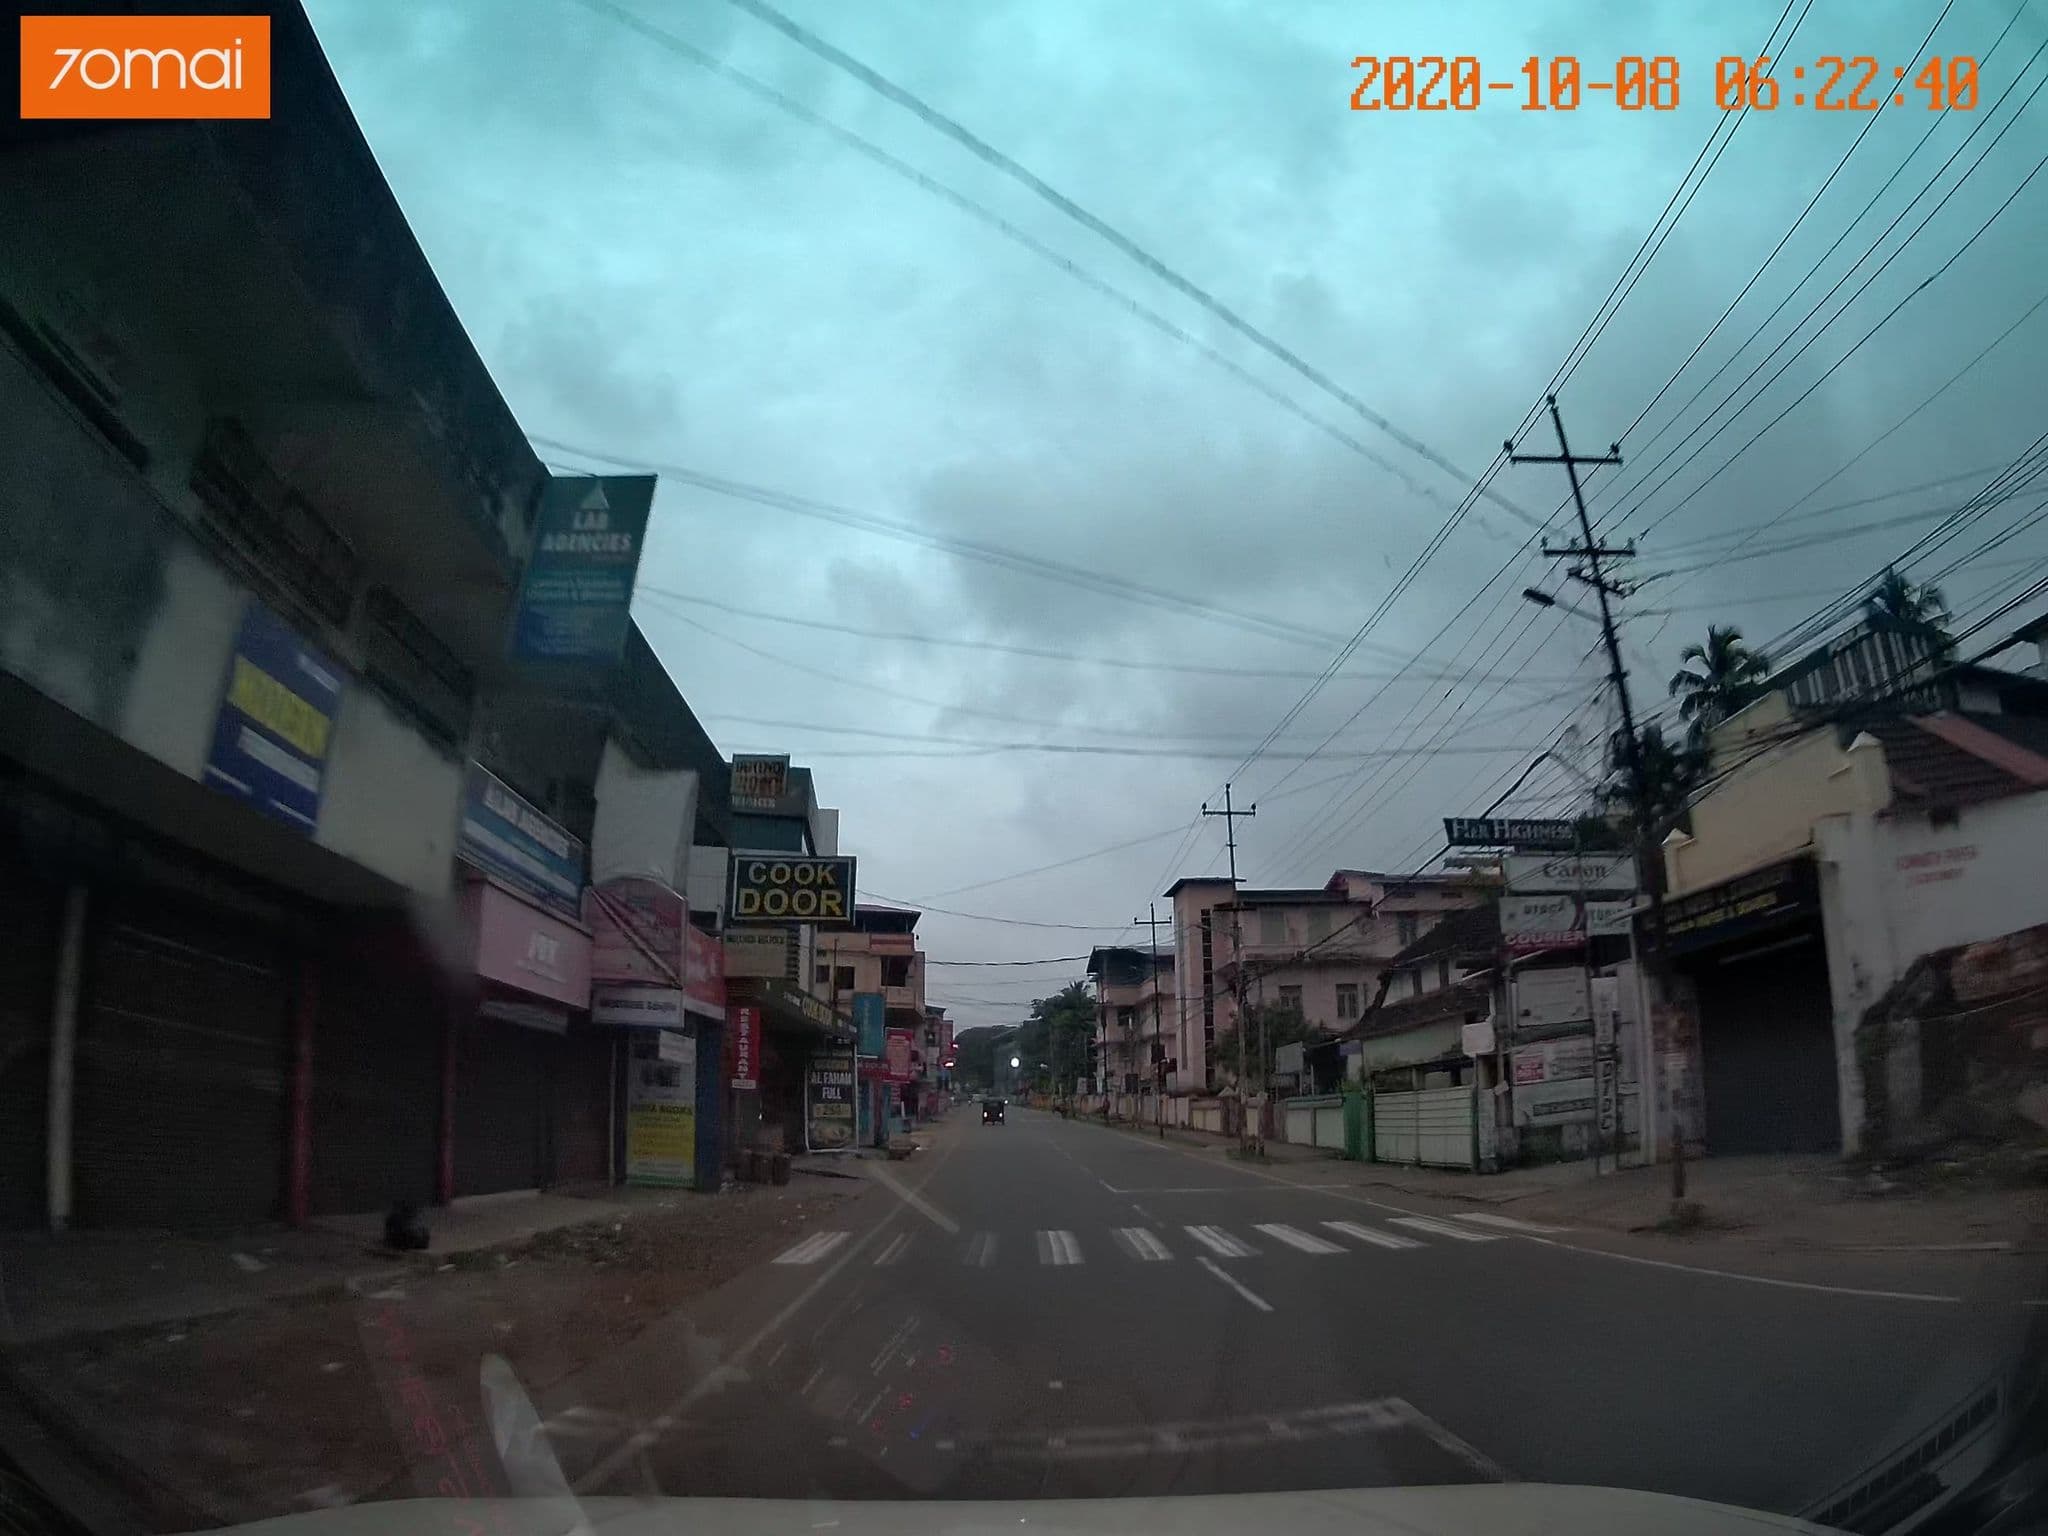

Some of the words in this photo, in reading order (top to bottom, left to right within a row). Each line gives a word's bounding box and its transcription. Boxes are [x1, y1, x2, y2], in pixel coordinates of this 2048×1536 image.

[749, 862, 836, 885] COOK
[740, 888, 843, 916] DOOR
[737, 1008, 750, 1080] RESTAURANT
[822, 1087, 841, 1100] FULL
